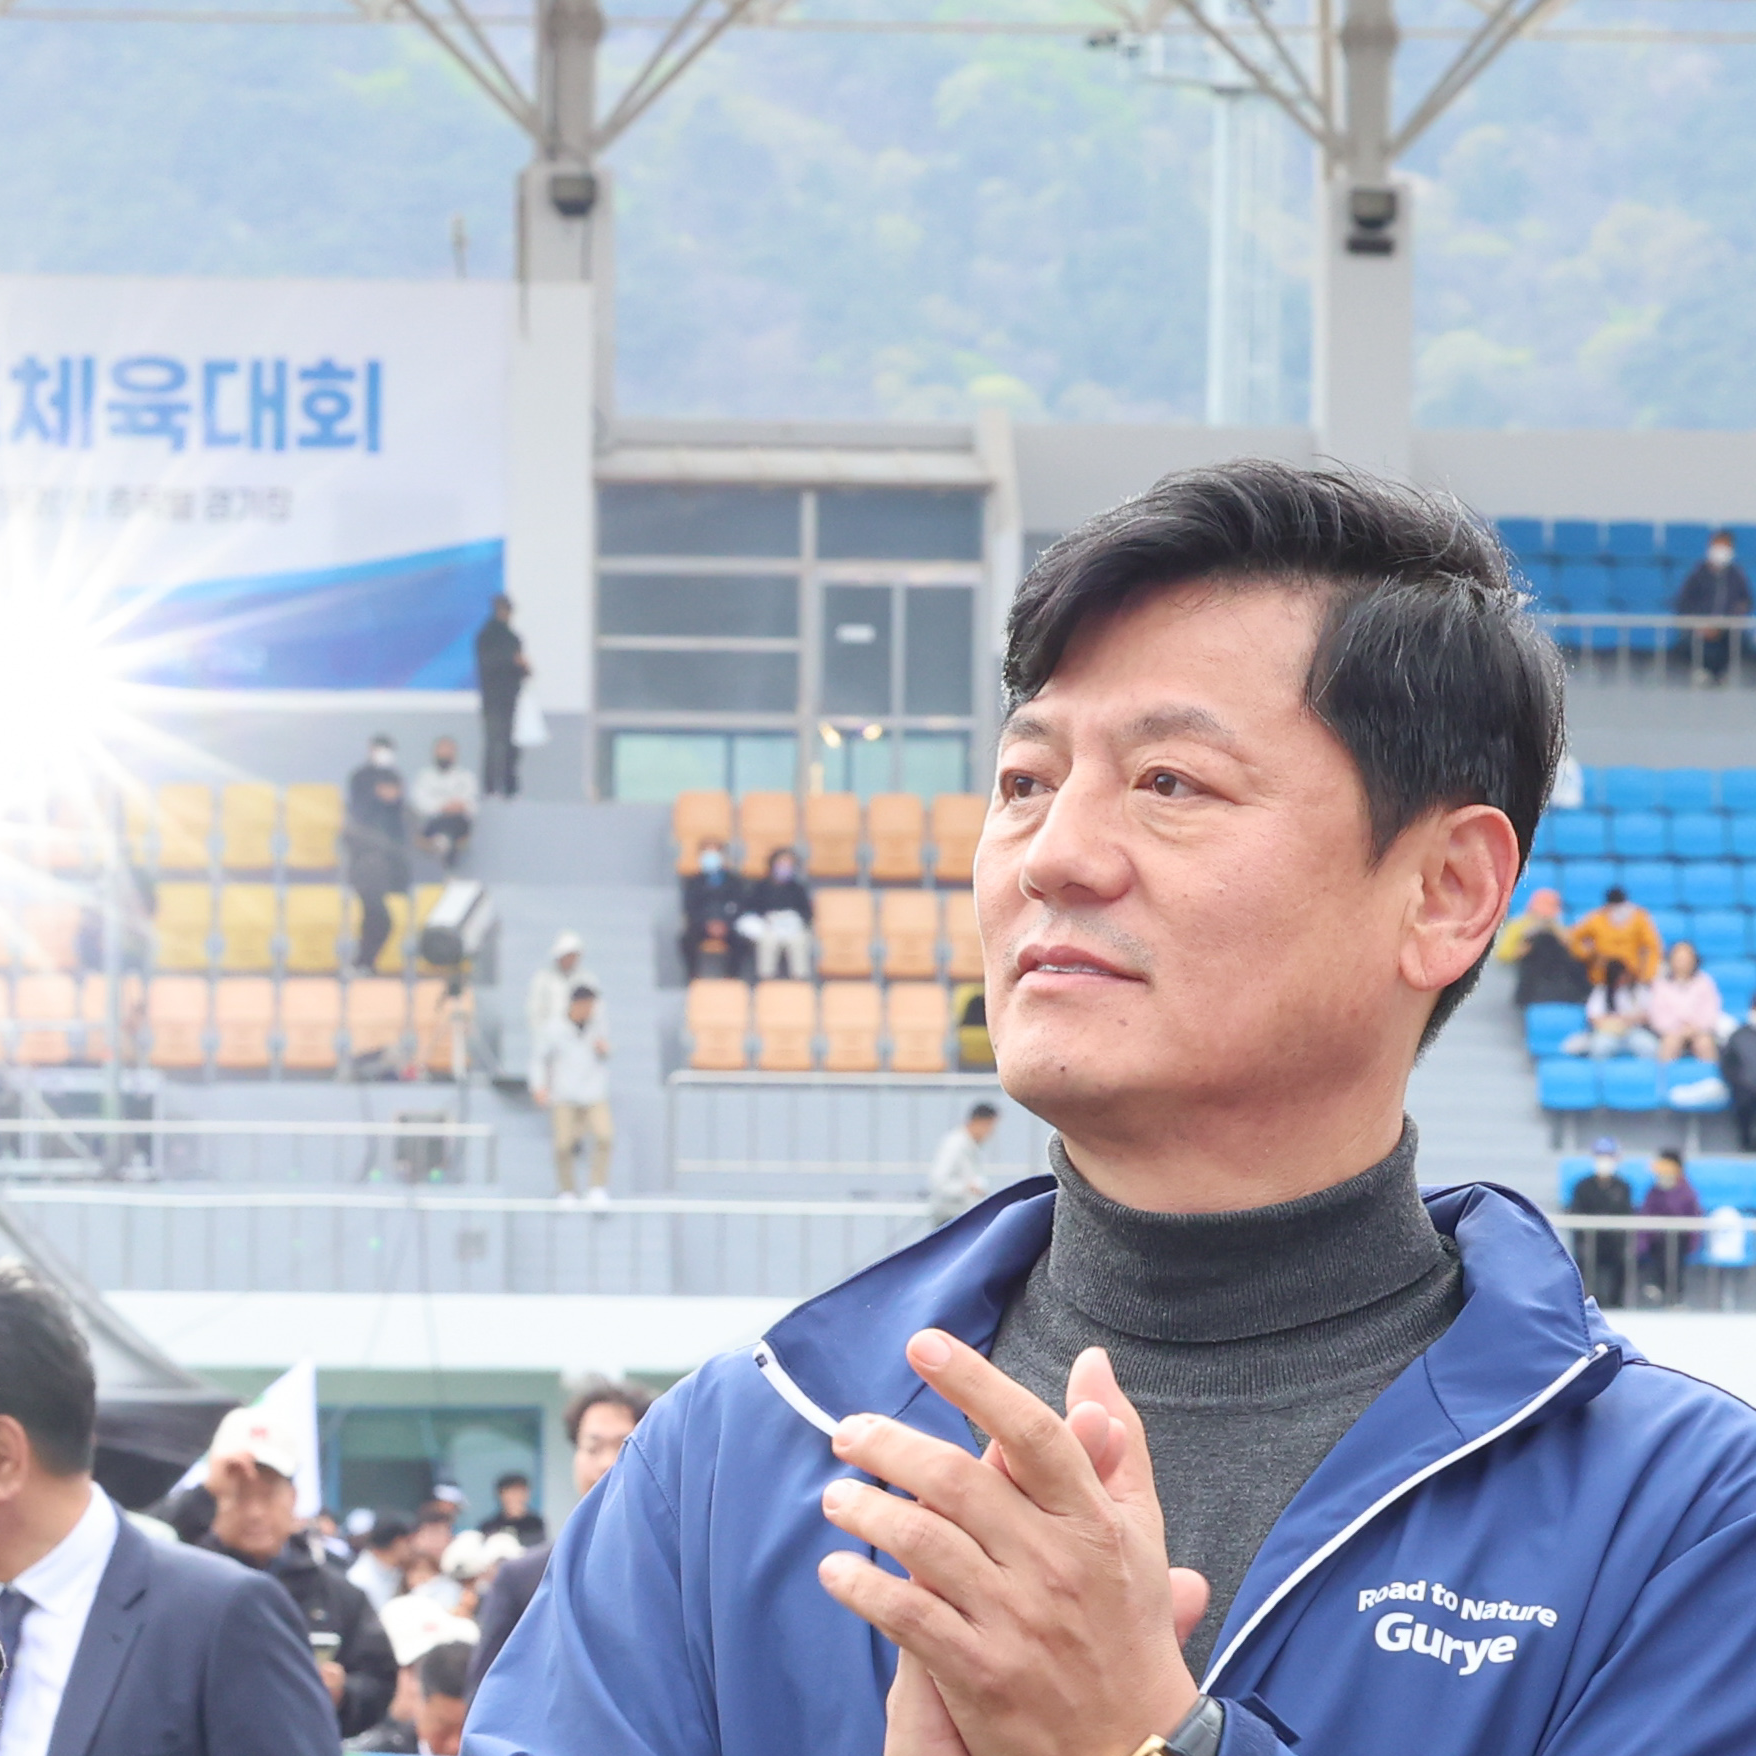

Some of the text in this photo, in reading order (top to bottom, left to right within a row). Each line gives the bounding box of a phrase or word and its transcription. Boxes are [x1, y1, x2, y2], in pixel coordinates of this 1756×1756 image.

[1358, 1580, 1558, 1628] Road to Nature
[1374, 1611, 1518, 1676] Gurye
